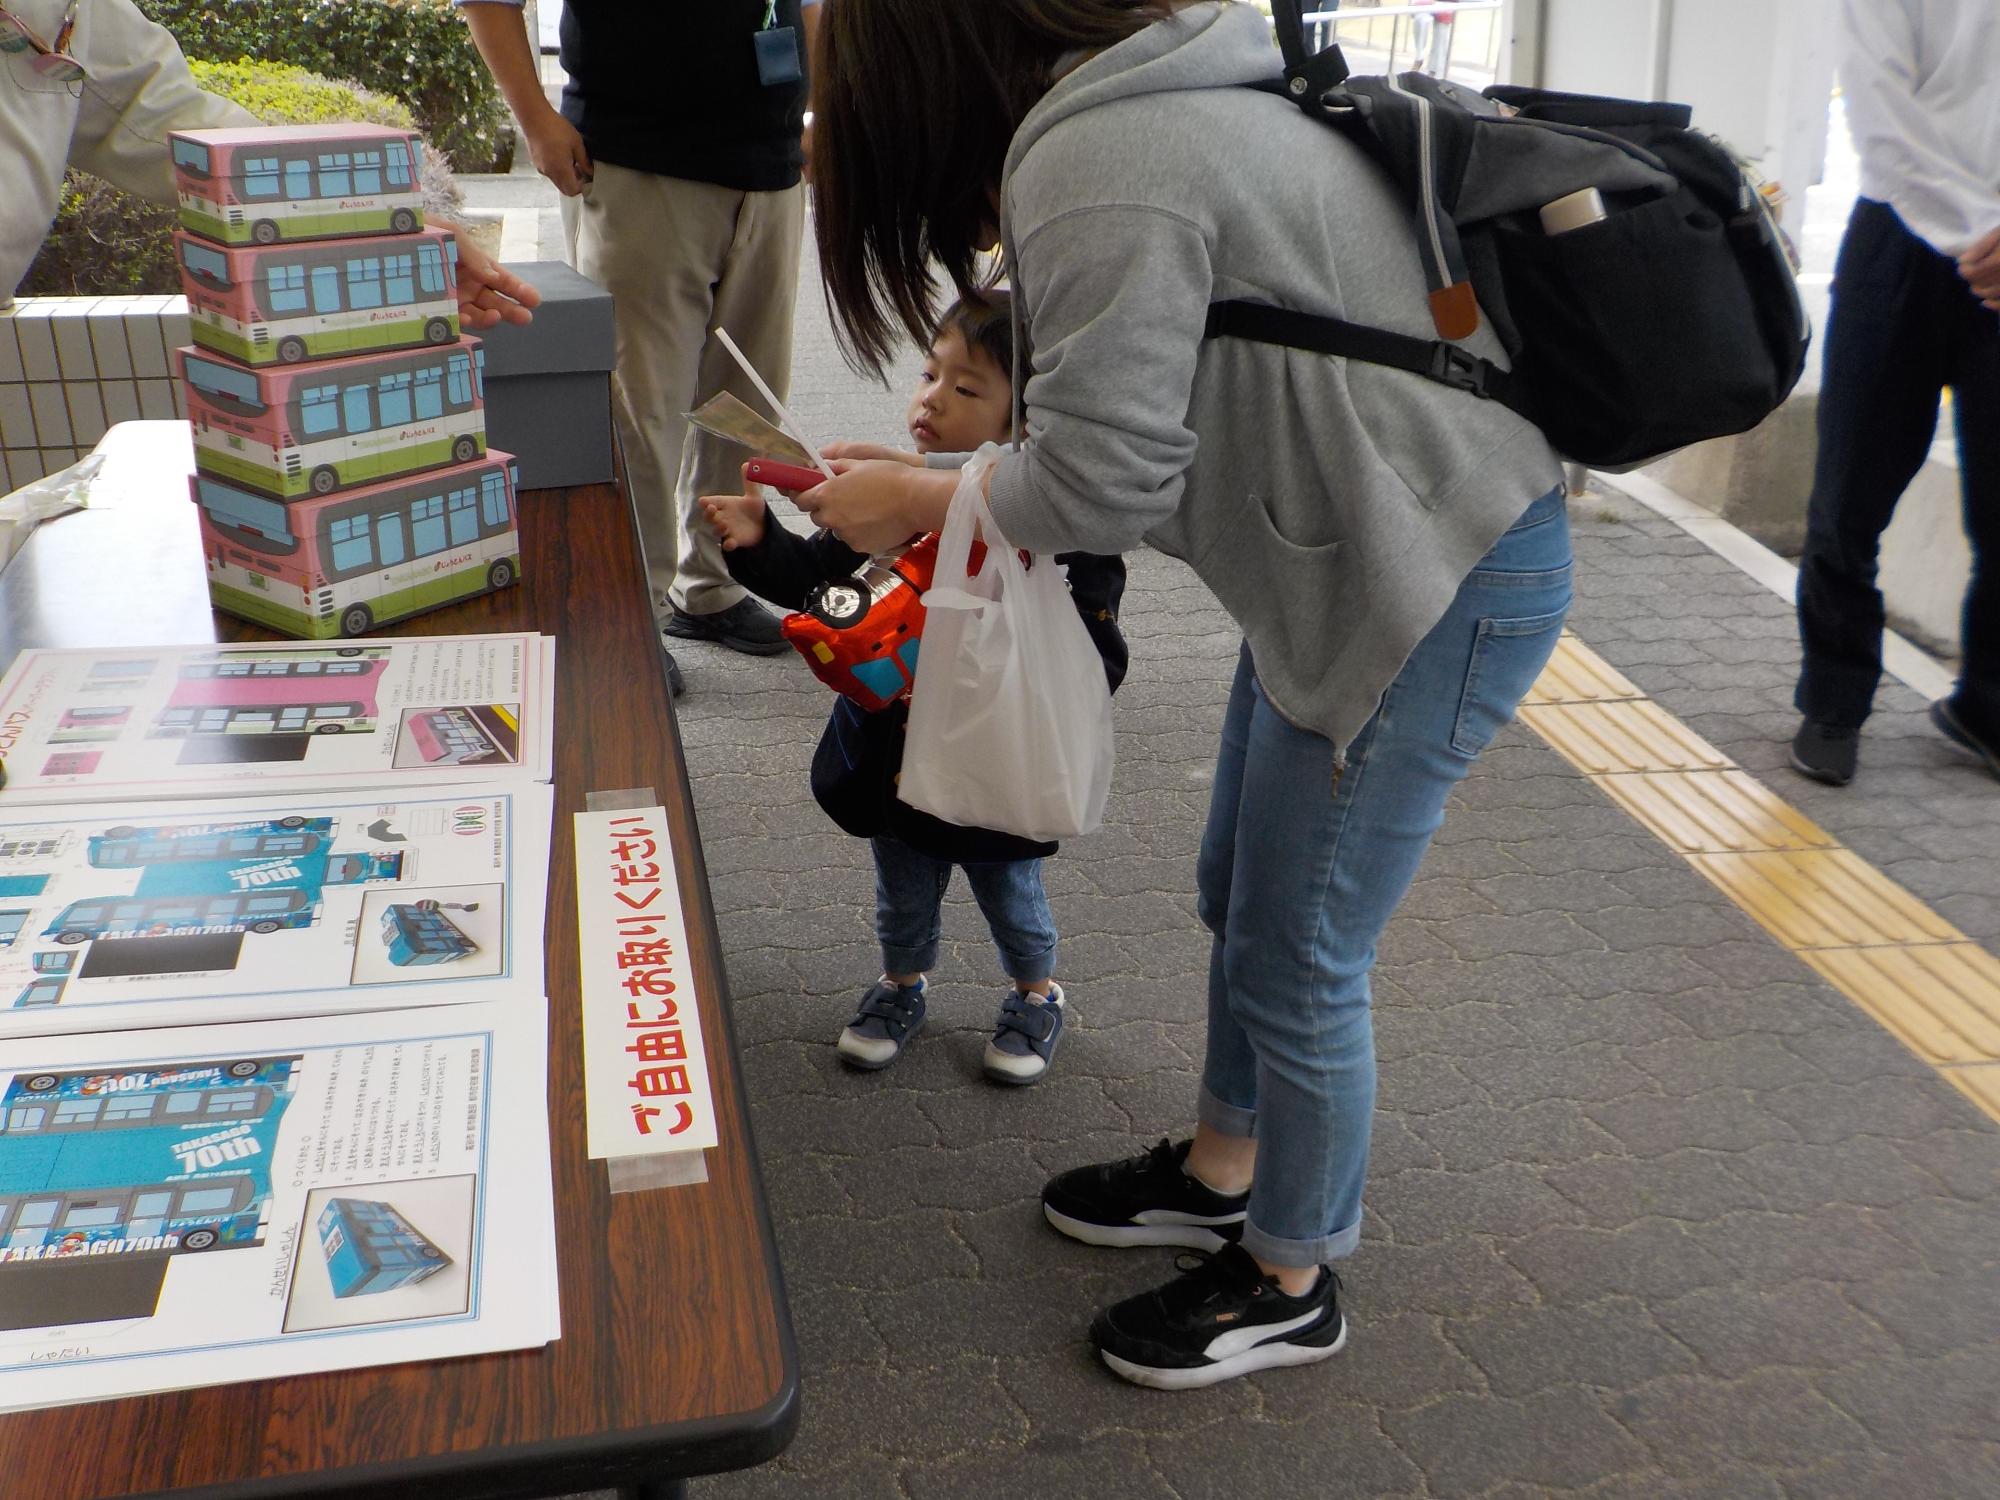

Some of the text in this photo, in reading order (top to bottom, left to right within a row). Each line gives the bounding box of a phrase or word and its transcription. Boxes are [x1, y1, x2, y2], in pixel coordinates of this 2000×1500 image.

[232, 866, 303, 889] 70th
[609, 817, 693, 1135] ご自由にお取りください
[170, 1124, 252, 1154] TAKASAGO
[175, 1135, 262, 1174] 70th
[31, 1346, 89, 1360] しゃたい
